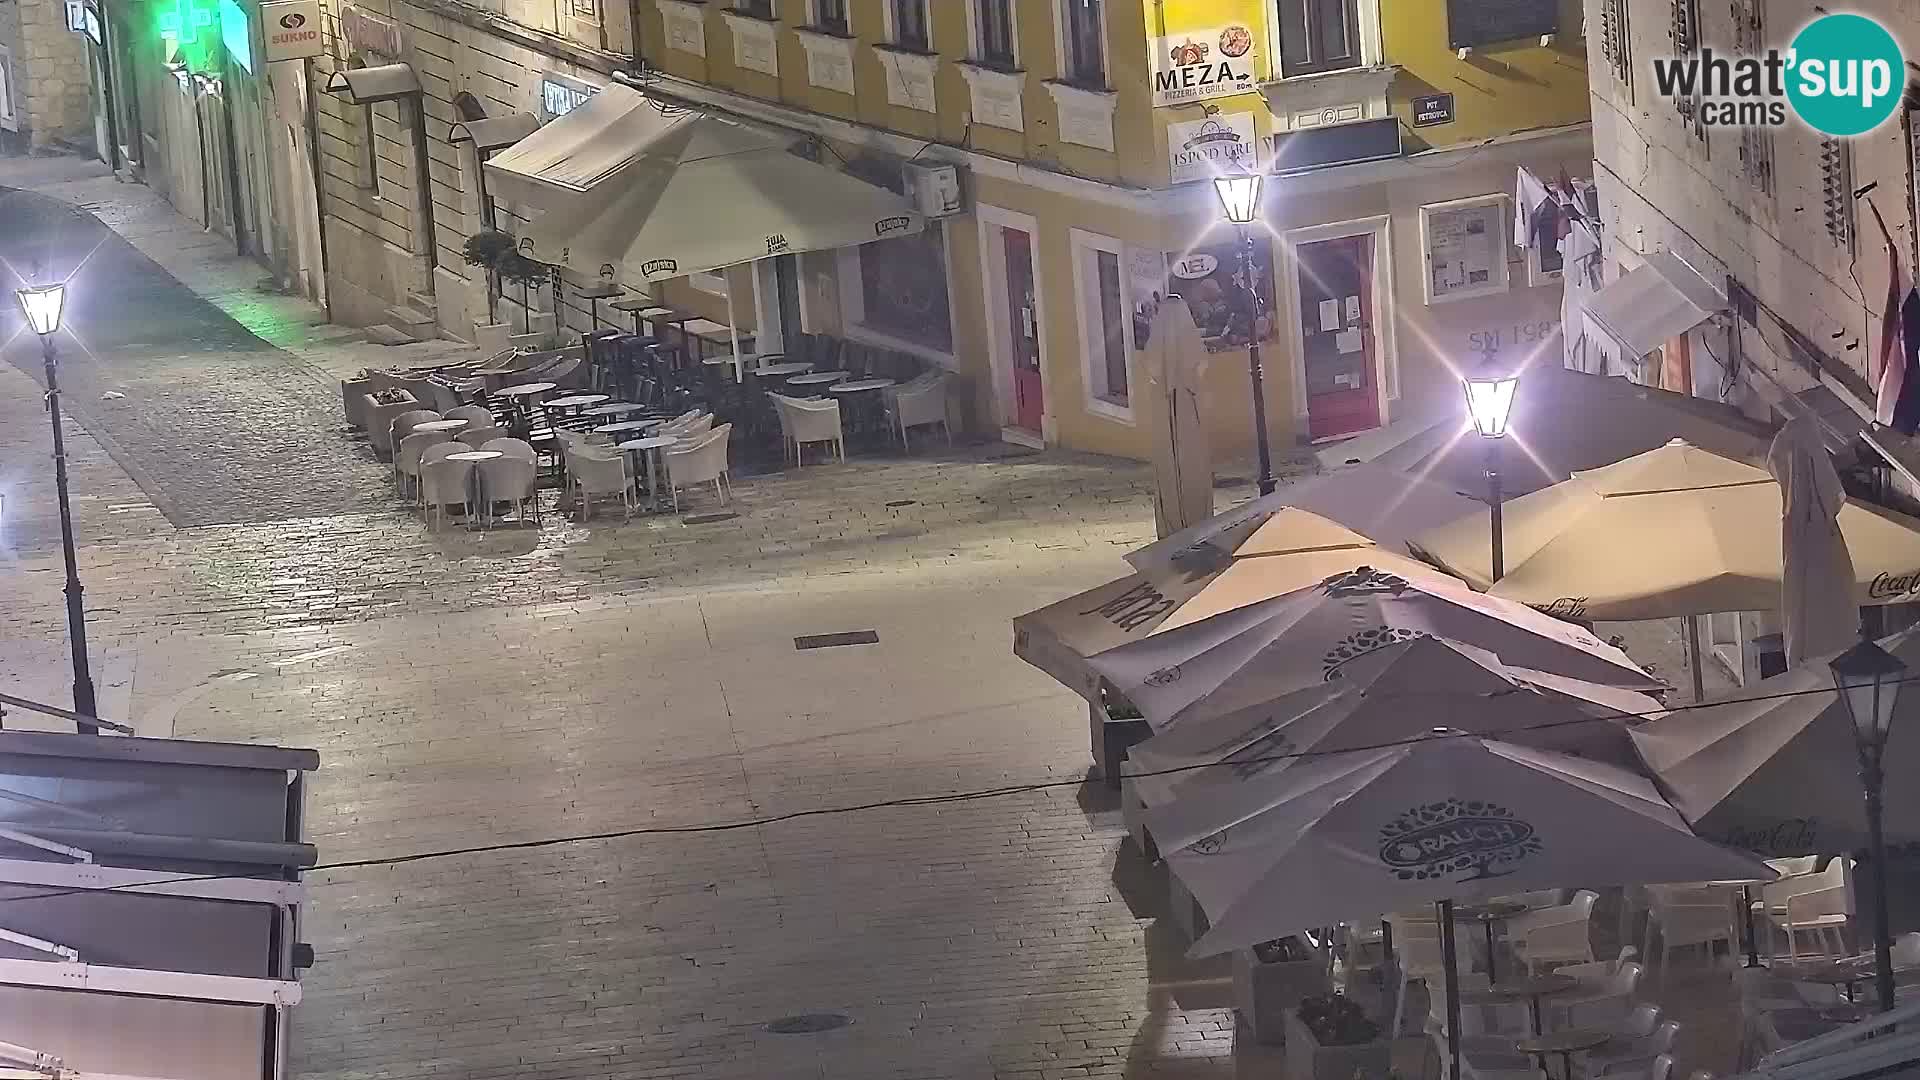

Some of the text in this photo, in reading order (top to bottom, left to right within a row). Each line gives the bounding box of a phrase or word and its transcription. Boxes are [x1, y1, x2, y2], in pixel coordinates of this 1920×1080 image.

[272, 30, 317, 44] SUKNO
[1155, 61, 1234, 91] MEZA
[1164, 88, 1198, 100] PIZZERIA
[1205, 84, 1226, 94] GRILL
[1174, 147, 1219, 166] ISPOD
[1421, 822, 1517, 855] RAUCH
